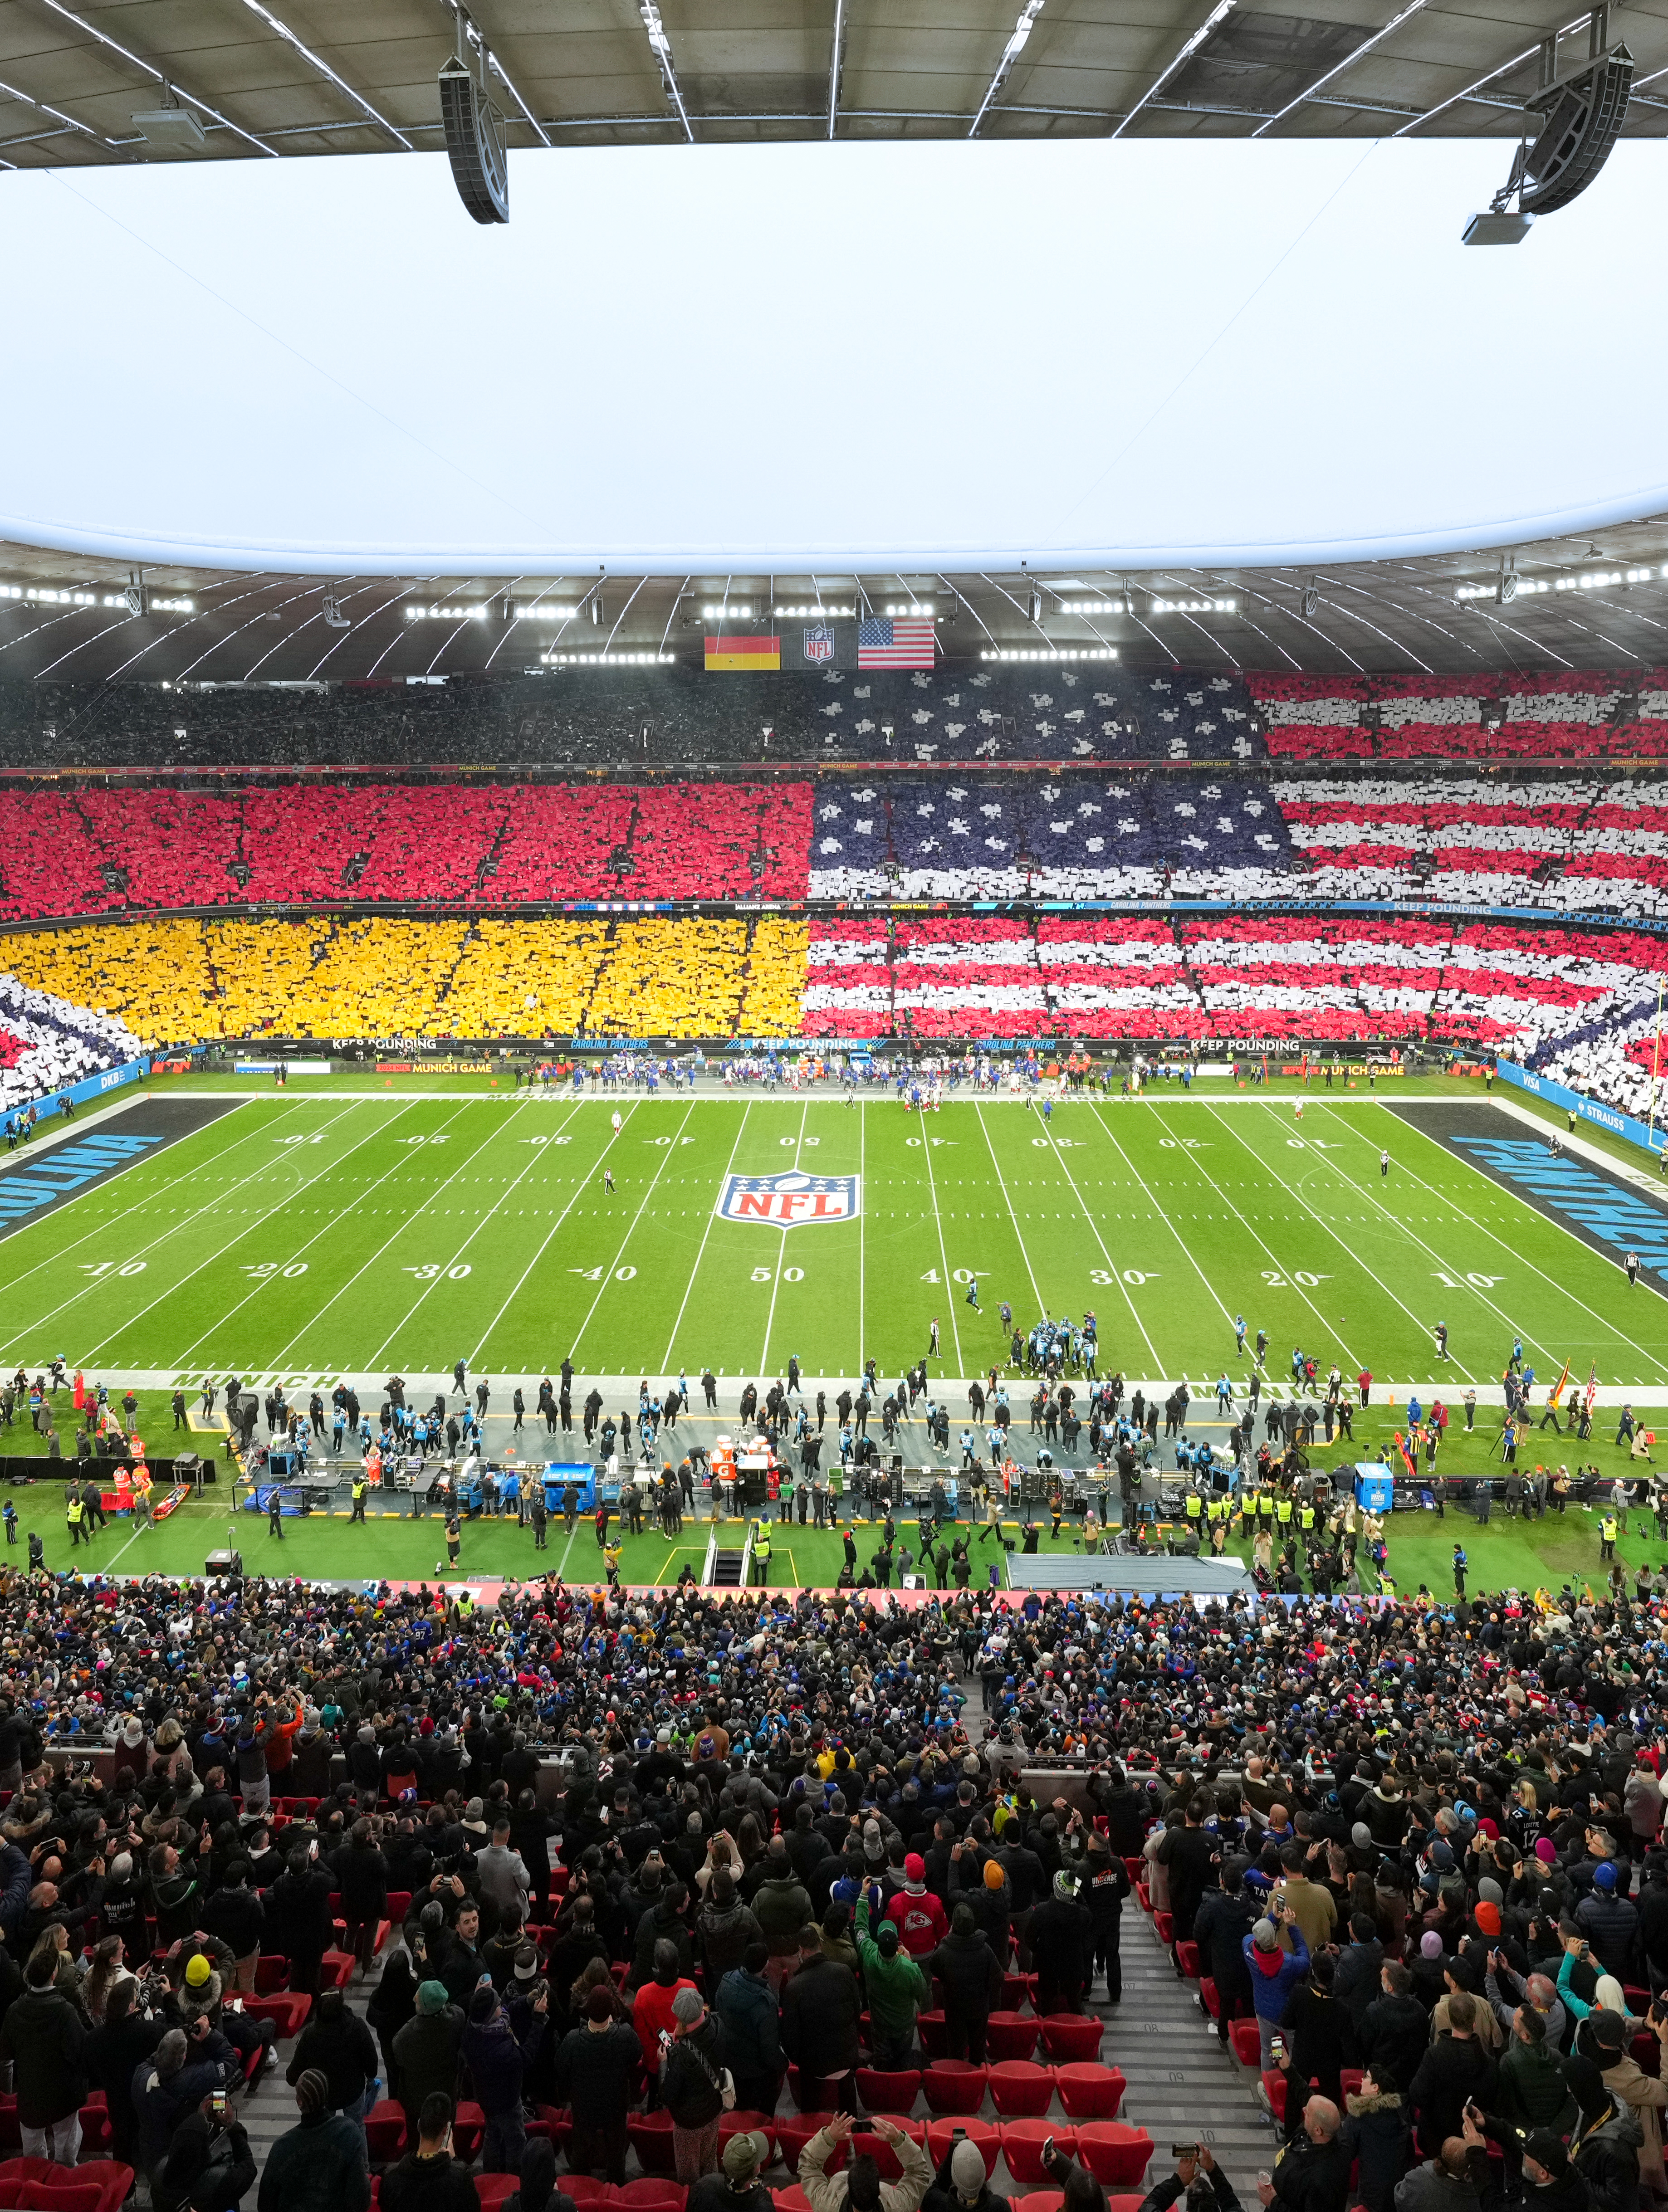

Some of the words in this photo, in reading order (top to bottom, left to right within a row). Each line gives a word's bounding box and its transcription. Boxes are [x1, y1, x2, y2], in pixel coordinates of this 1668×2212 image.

[807, 642, 829, 659] NFL
[1394, 902, 1423, 911] KEEP
[1427, 903, 1492, 915] POUNDING
[570, 1040, 607, 1049] CAROLINA
[610, 1040, 649, 1049] PANTHERS
[752, 1039, 786, 1049] KEEP
[788, 1039, 857, 1050] POUNDING
[1016, 1040, 1056, 1050] PANTHERS
[1228, 1041, 1300, 1051] POUNDING
[412, 1064, 457, 1073] MUNICH
[460, 1064, 492, 1073] GAME
[101, 1071, 119, 1089] DKB
[1521, 1073, 1540, 1092] VISA
[1587, 1105, 1625, 1133] STRAUSS
[285, 1135, 329, 1144] 10
[407, 1135, 450, 1144] 20
[530, 1136, 572, 1144] 30
[654, 1136, 695, 1145] 40
[779, 1137, 821, 1146] 50
[905, 1138, 946, 1147] 40
[1032, 1138, 1073, 1148] 30
[1159, 1138, 1201, 1148] 20
[1286, 1139, 1333, 1149] 10
[734, 1194, 815, 1220] NFL
[83, 1262, 147, 1276] 10
[246, 1263, 309, 1277] 20
[414, 1264, 472, 1279] 30
[582, 1265, 637, 1280] 40
[750, 1267, 805, 1282] 50
[920, 1268, 973, 1283] 40
[1089, 1269, 1146, 1285] 30
[1260, 1271, 1319, 1287] 20
[1430, 1272, 1494, 1288] 10
[169, 1373, 341, 1389] MUNICH
[1092, 1385, 1102, 1394] 98
[403, 1415, 411, 1423] 77
[416, 1424, 426, 1432] 50
[1104, 1427, 1114, 1437] 94
[991, 1432, 1001, 1441] 47
[1129, 1430, 1139, 1440] 92
[961, 1438, 971, 1447] 56
[1189, 1452, 1196, 1461] 7
[717, 1465, 729, 1476] G
[415, 1631, 425, 1641] 97
[402, 1651, 406, 1660] 1
[1511, 1809, 1524, 1820] 17
[1522, 1830, 1540, 1849] 17
[1223, 1841, 1235, 1856] 5
[1092, 1873, 1117, 1885] UNIVERSE
[1122, 1982, 1135, 1990] 07
[1144, 2022, 1159, 2032] 08
[1169, 2071, 1184, 2082] 09
[1200, 2129, 1215, 2142] 10
